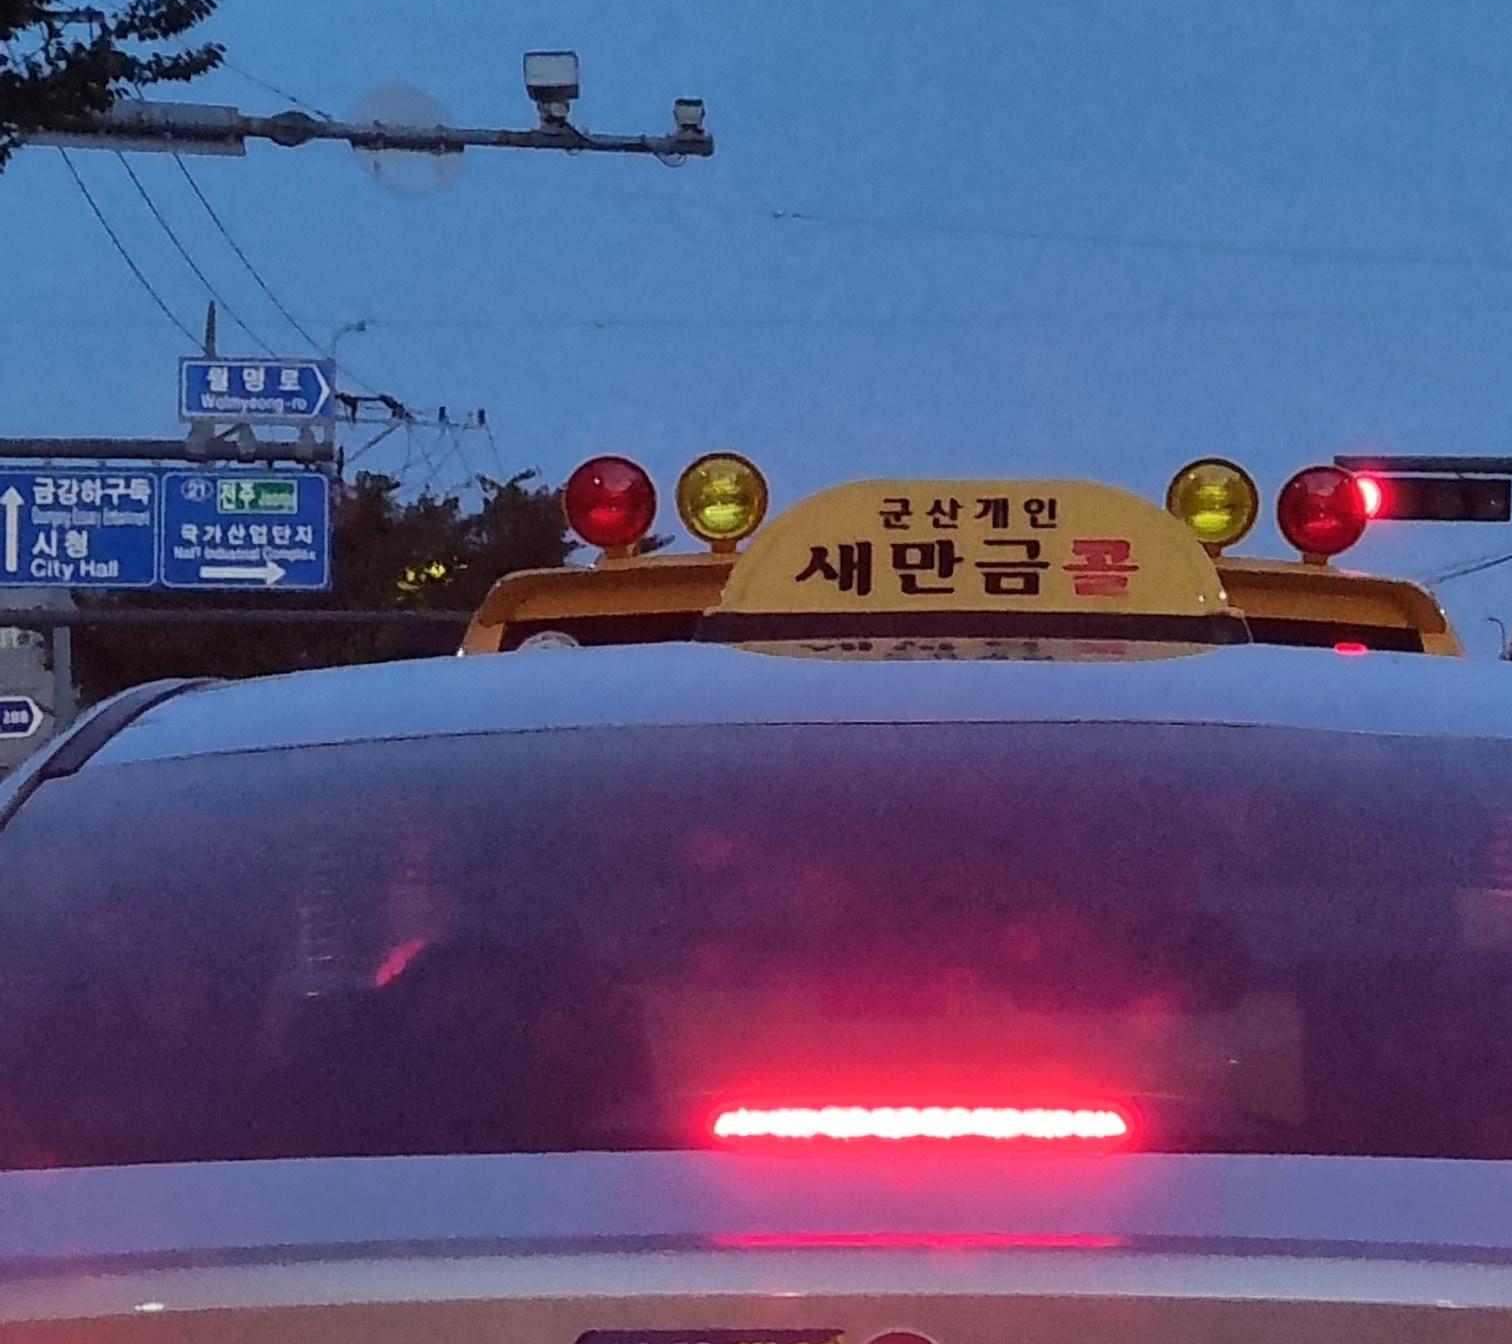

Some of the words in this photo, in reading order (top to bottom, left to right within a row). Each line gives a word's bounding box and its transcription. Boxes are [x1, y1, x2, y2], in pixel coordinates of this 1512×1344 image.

[187, 482, 208, 498] 21
[879, 497, 1058, 531] 군산개인
[32, 530, 89, 558] 시청
[181, 524, 313, 546] 국가산업단지
[31, 558, 74, 581] City
[77, 558, 119, 578] Hall
[795, 538, 1140, 598] 새만금콜
